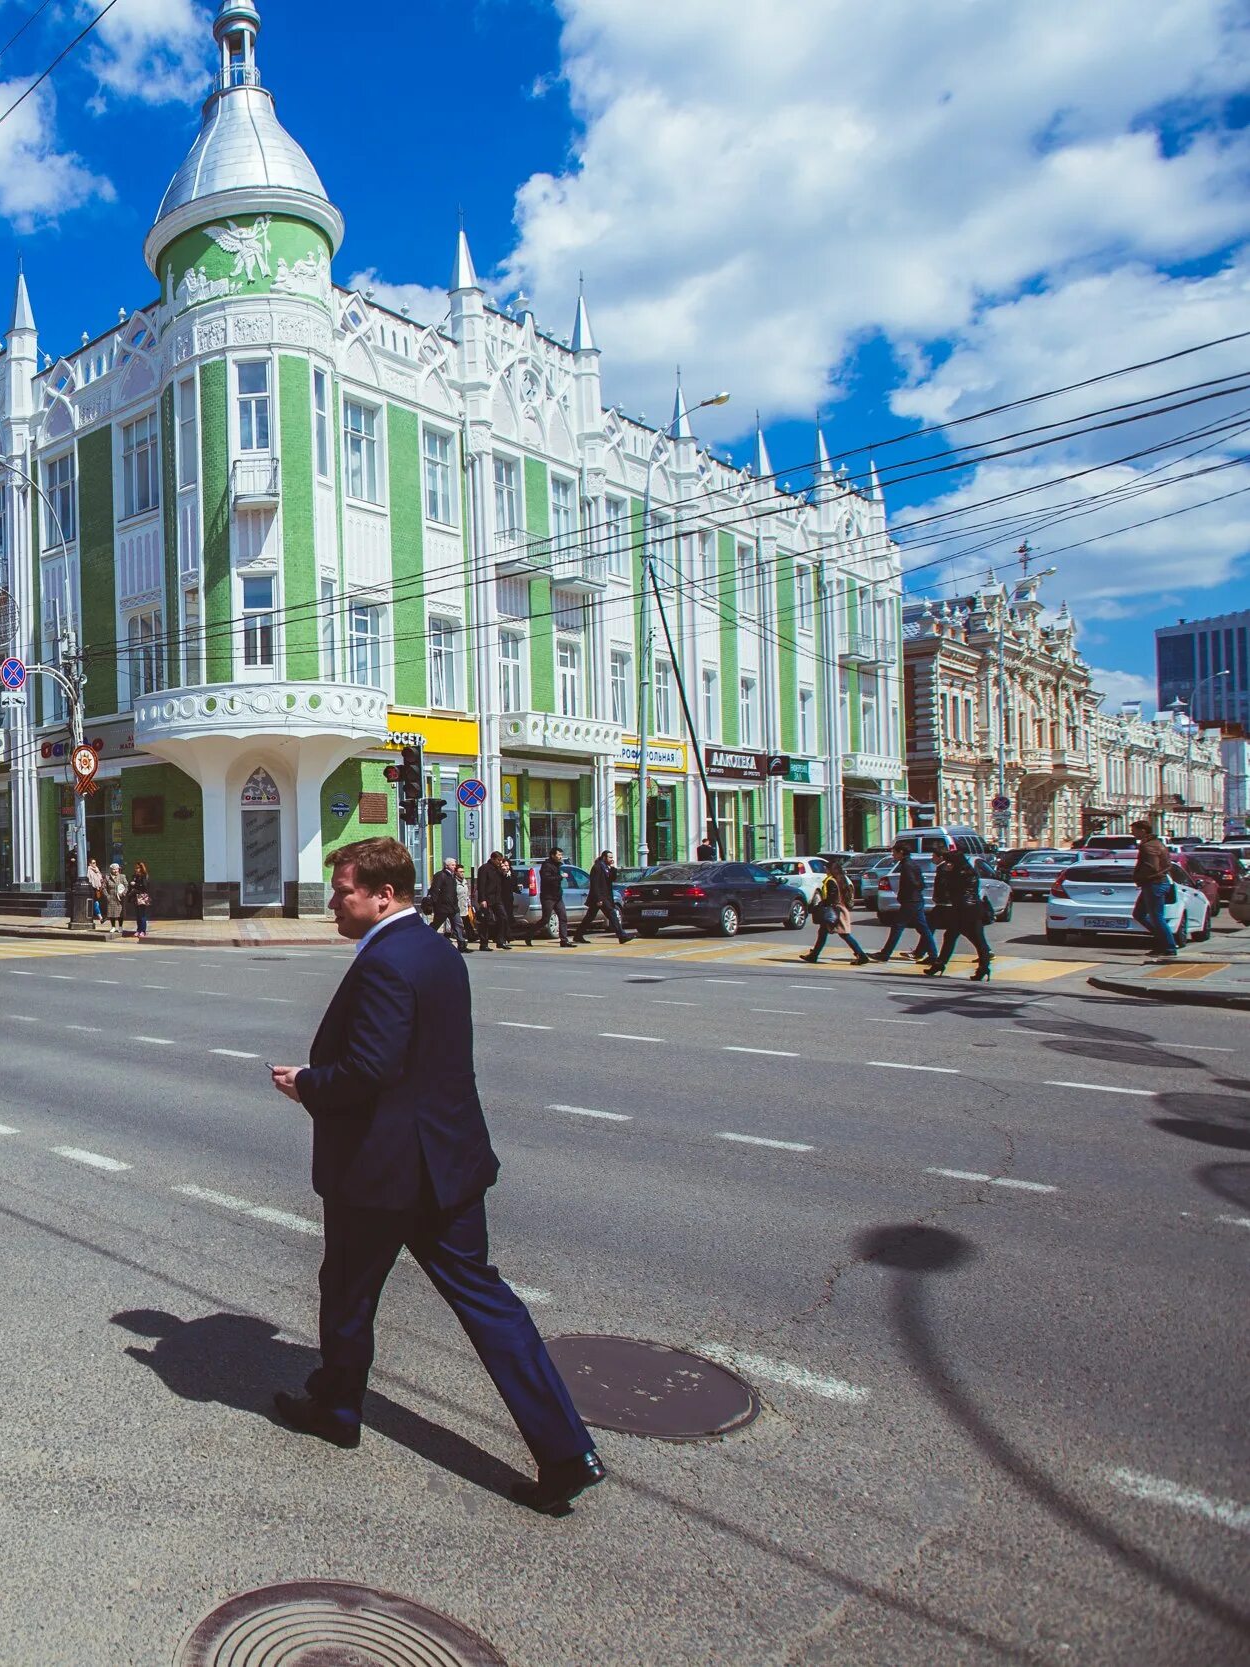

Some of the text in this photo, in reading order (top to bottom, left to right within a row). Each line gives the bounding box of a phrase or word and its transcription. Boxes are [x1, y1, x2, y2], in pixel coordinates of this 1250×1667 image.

[621, 748, 675, 762] РОФИОЛЬНАЯ
[712, 751, 757, 770] АЛКОТЕКА
[469, 821, 475, 830] 5
